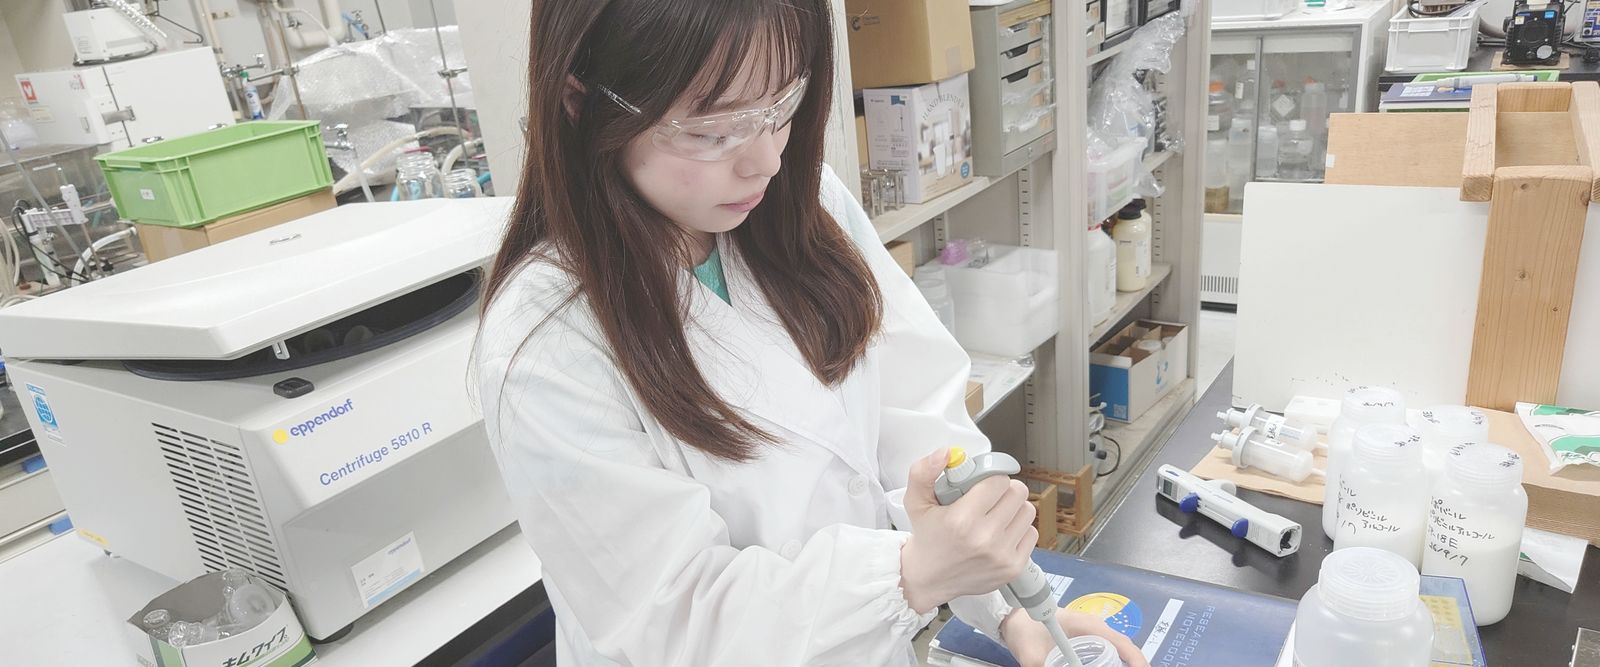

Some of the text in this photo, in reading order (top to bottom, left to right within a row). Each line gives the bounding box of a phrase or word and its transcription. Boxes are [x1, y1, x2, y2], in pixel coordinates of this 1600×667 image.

[290, 398, 354, 437] eppendorf
[319, 421, 433, 486] Centrifuge 5810 R
